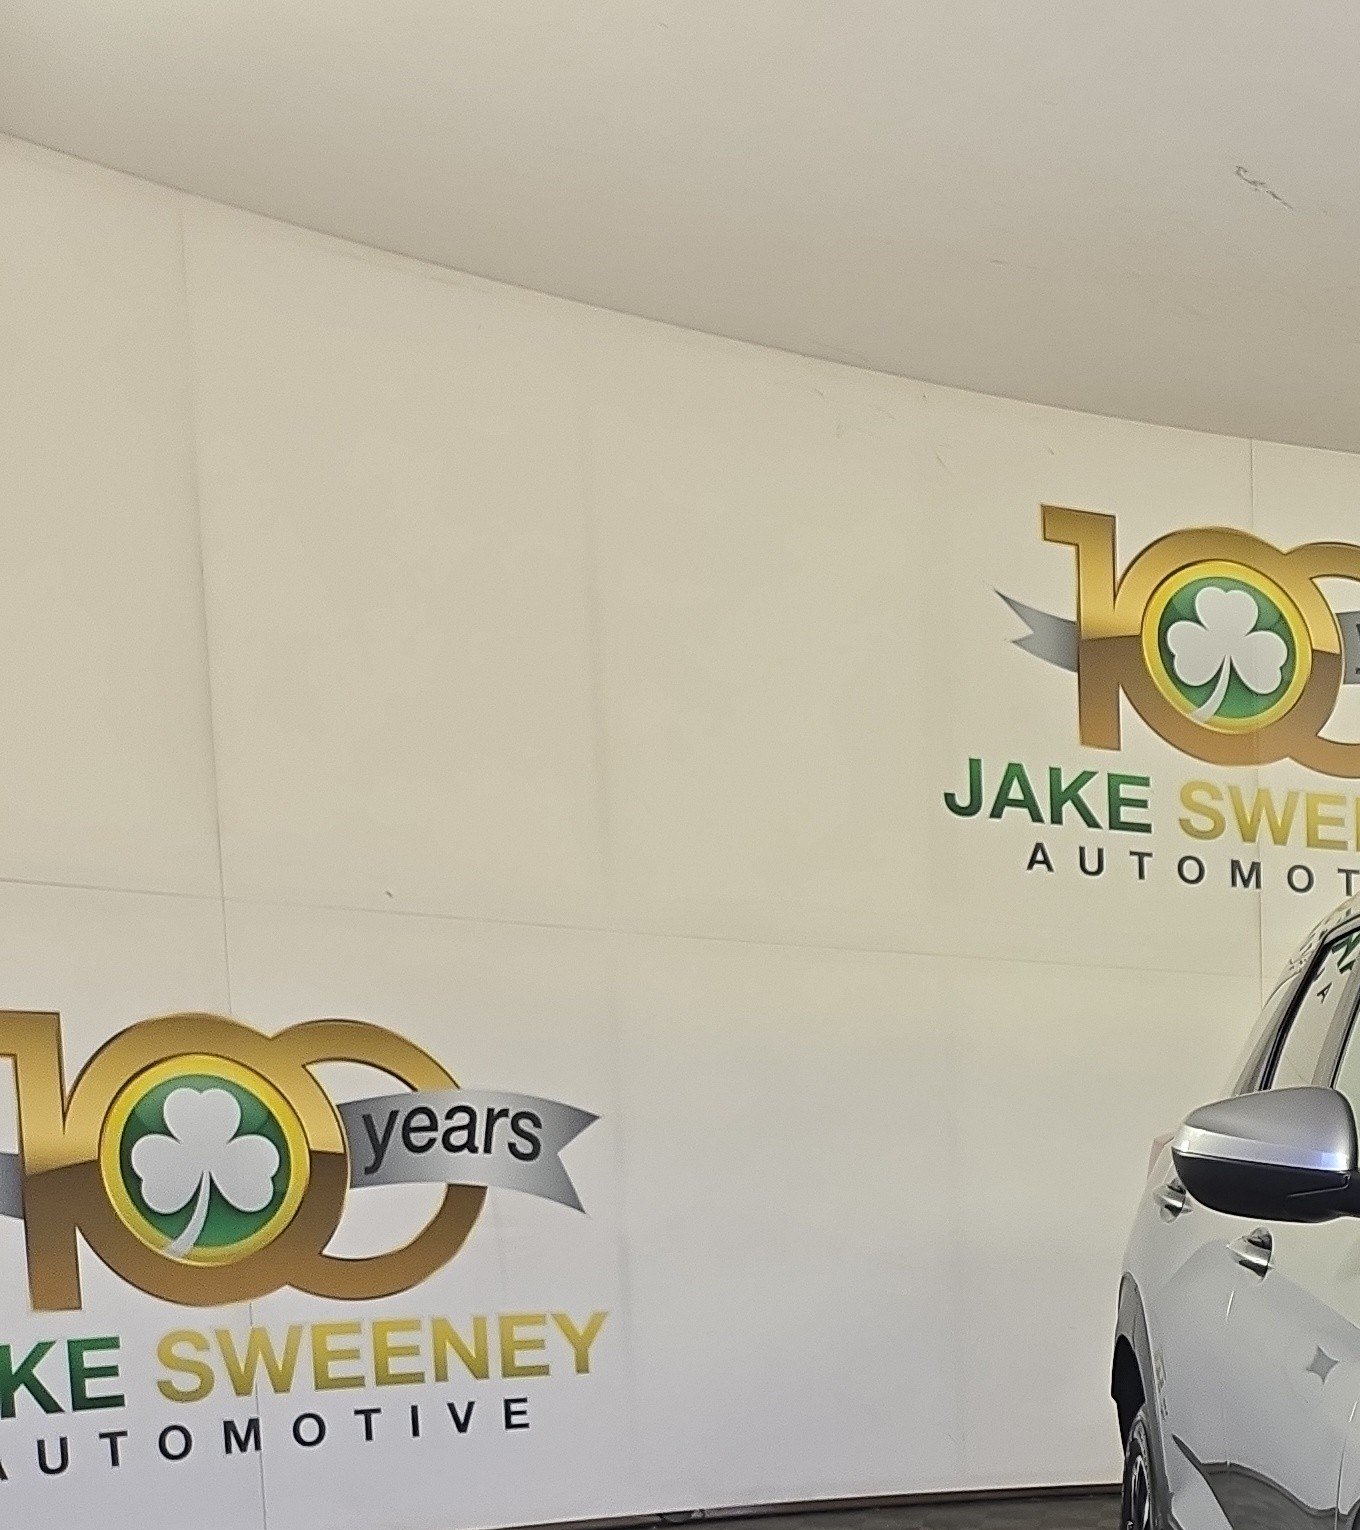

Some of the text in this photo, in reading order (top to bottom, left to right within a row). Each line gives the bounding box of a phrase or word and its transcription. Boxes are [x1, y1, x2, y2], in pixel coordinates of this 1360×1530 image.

[943, 757, 1153, 834] JAKE
[1026, 842, 1360, 897] AUTOMOT
[363, 1103, 542, 1175] years
[0, 1311, 608, 1419] KE SWEENEY
